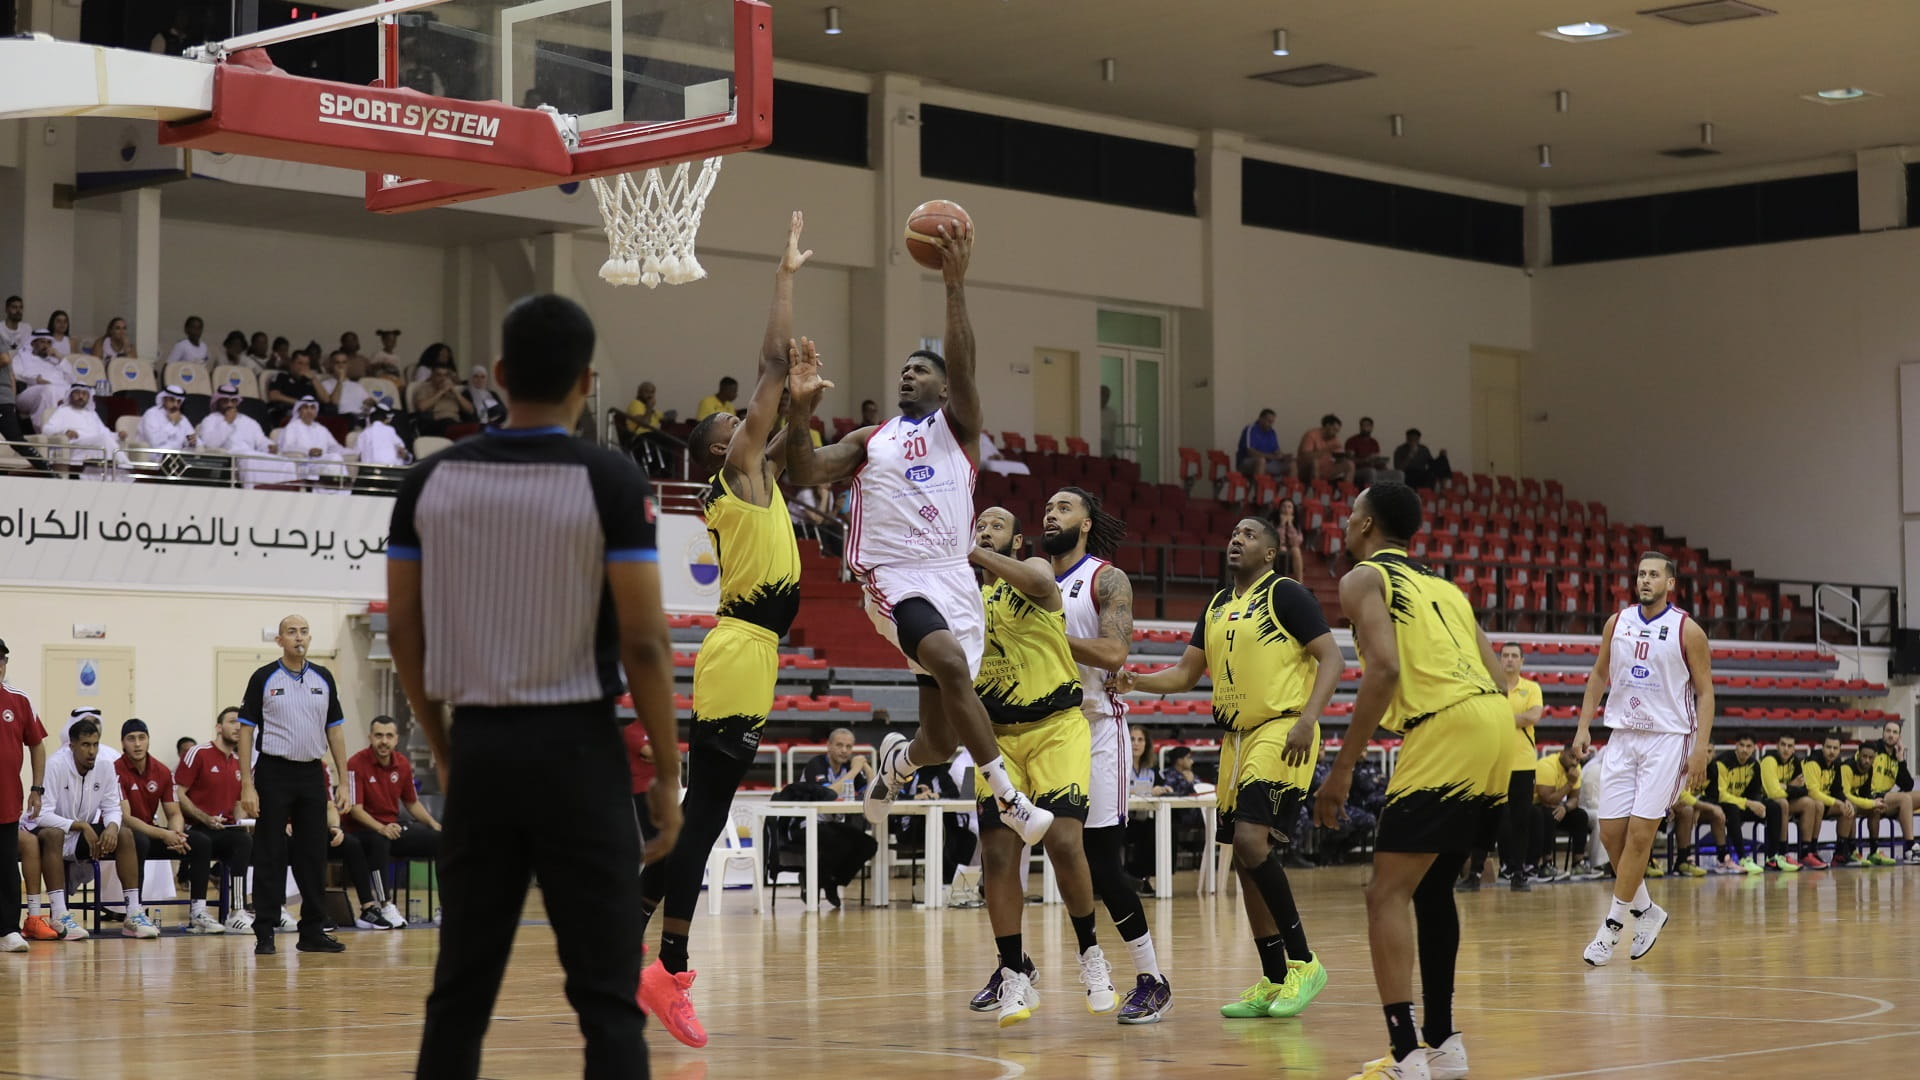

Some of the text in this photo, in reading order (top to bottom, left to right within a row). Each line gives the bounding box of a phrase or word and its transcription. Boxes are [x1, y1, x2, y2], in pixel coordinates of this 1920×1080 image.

[903, 436, 927, 460] 20
[0, 508, 88, 545] الكرام
[100, 512, 238, 557] بالضيوف
[250, 529, 334, 560] يرحب
[1226, 630, 1235, 652] 4
[1634, 641, 1649, 660] 10
[986, 659, 1009, 671] DUBAI
[995, 663, 1025, 675] ESTATE
[1269, 788, 1283, 816] 4
